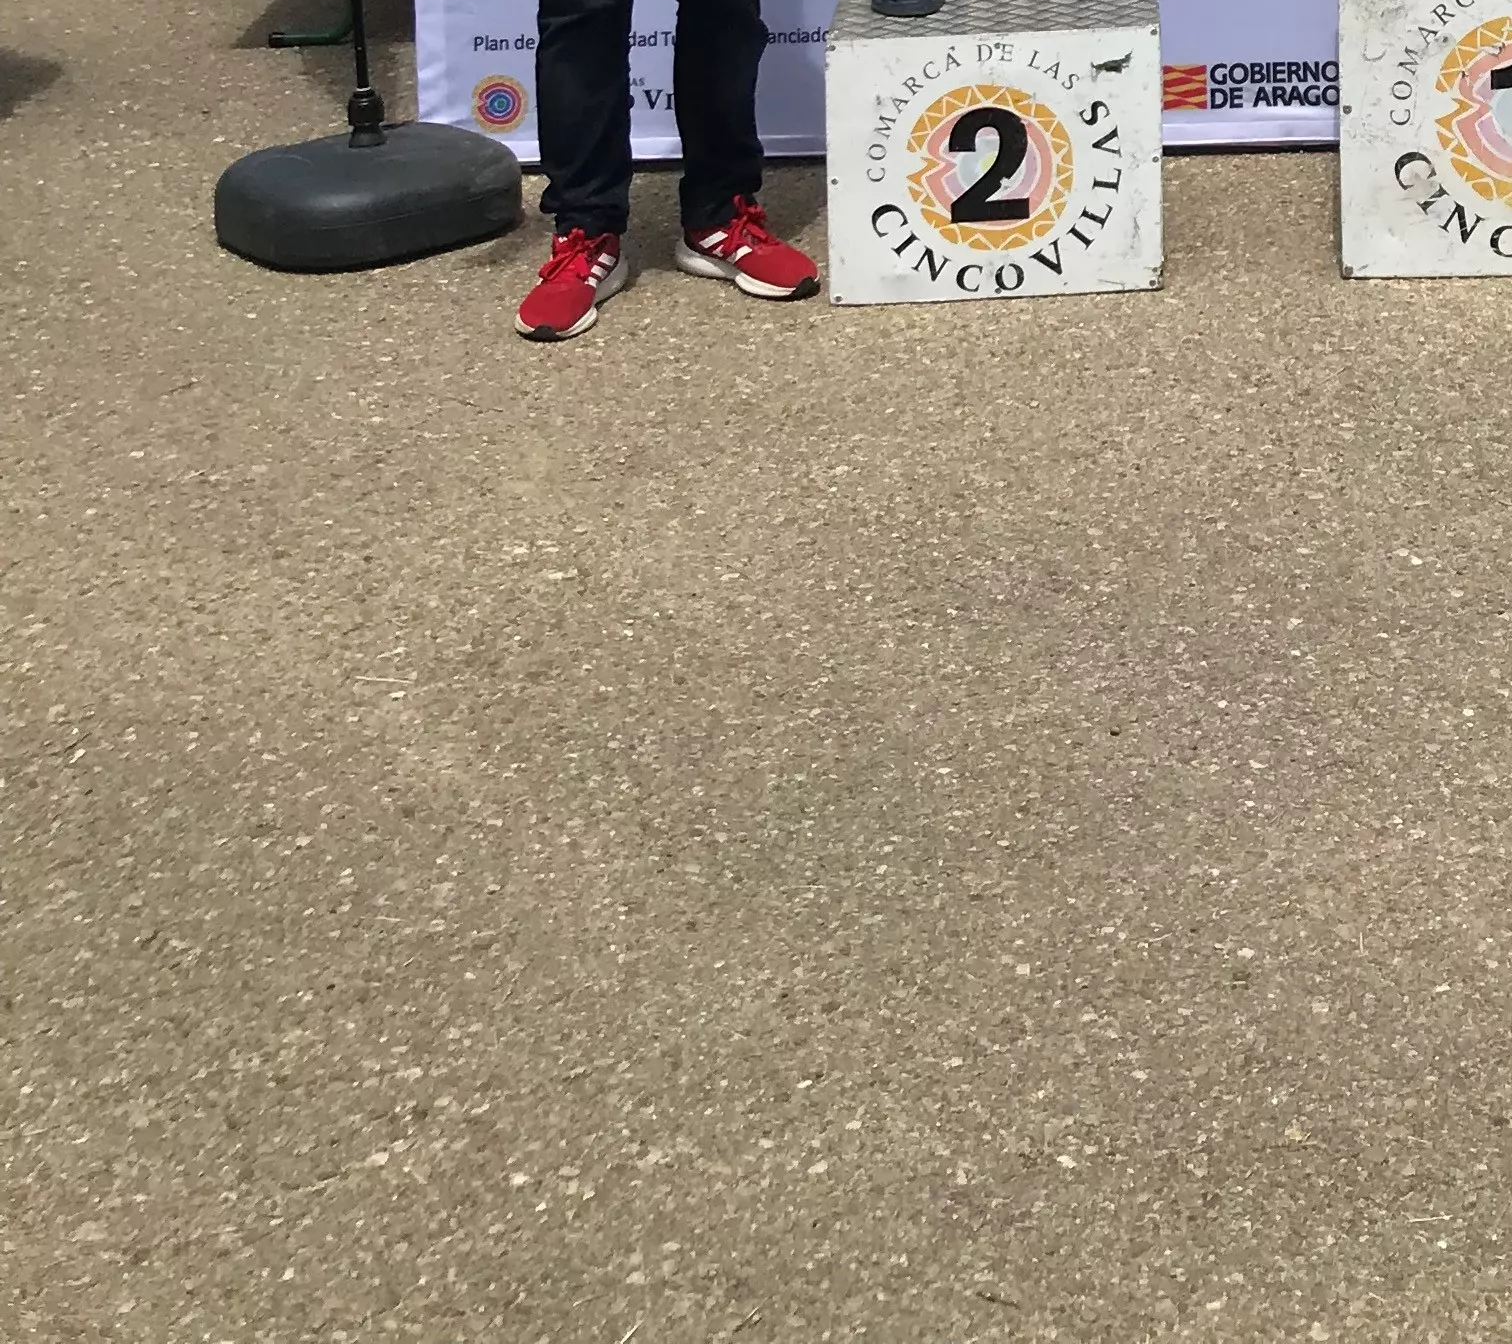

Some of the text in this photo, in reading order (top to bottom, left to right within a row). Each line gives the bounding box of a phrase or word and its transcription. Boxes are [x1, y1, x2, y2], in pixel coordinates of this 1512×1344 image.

[473, 35, 510, 52] Plan
[515, 34, 536, 50] de
[976, 43, 1014, 62] DE
[1027, 49, 1080, 91] LAS
[1209, 61, 1340, 86] GOBIERNO
[1210, 86, 1244, 110] DE
[948, 106, 1030, 224] 2
